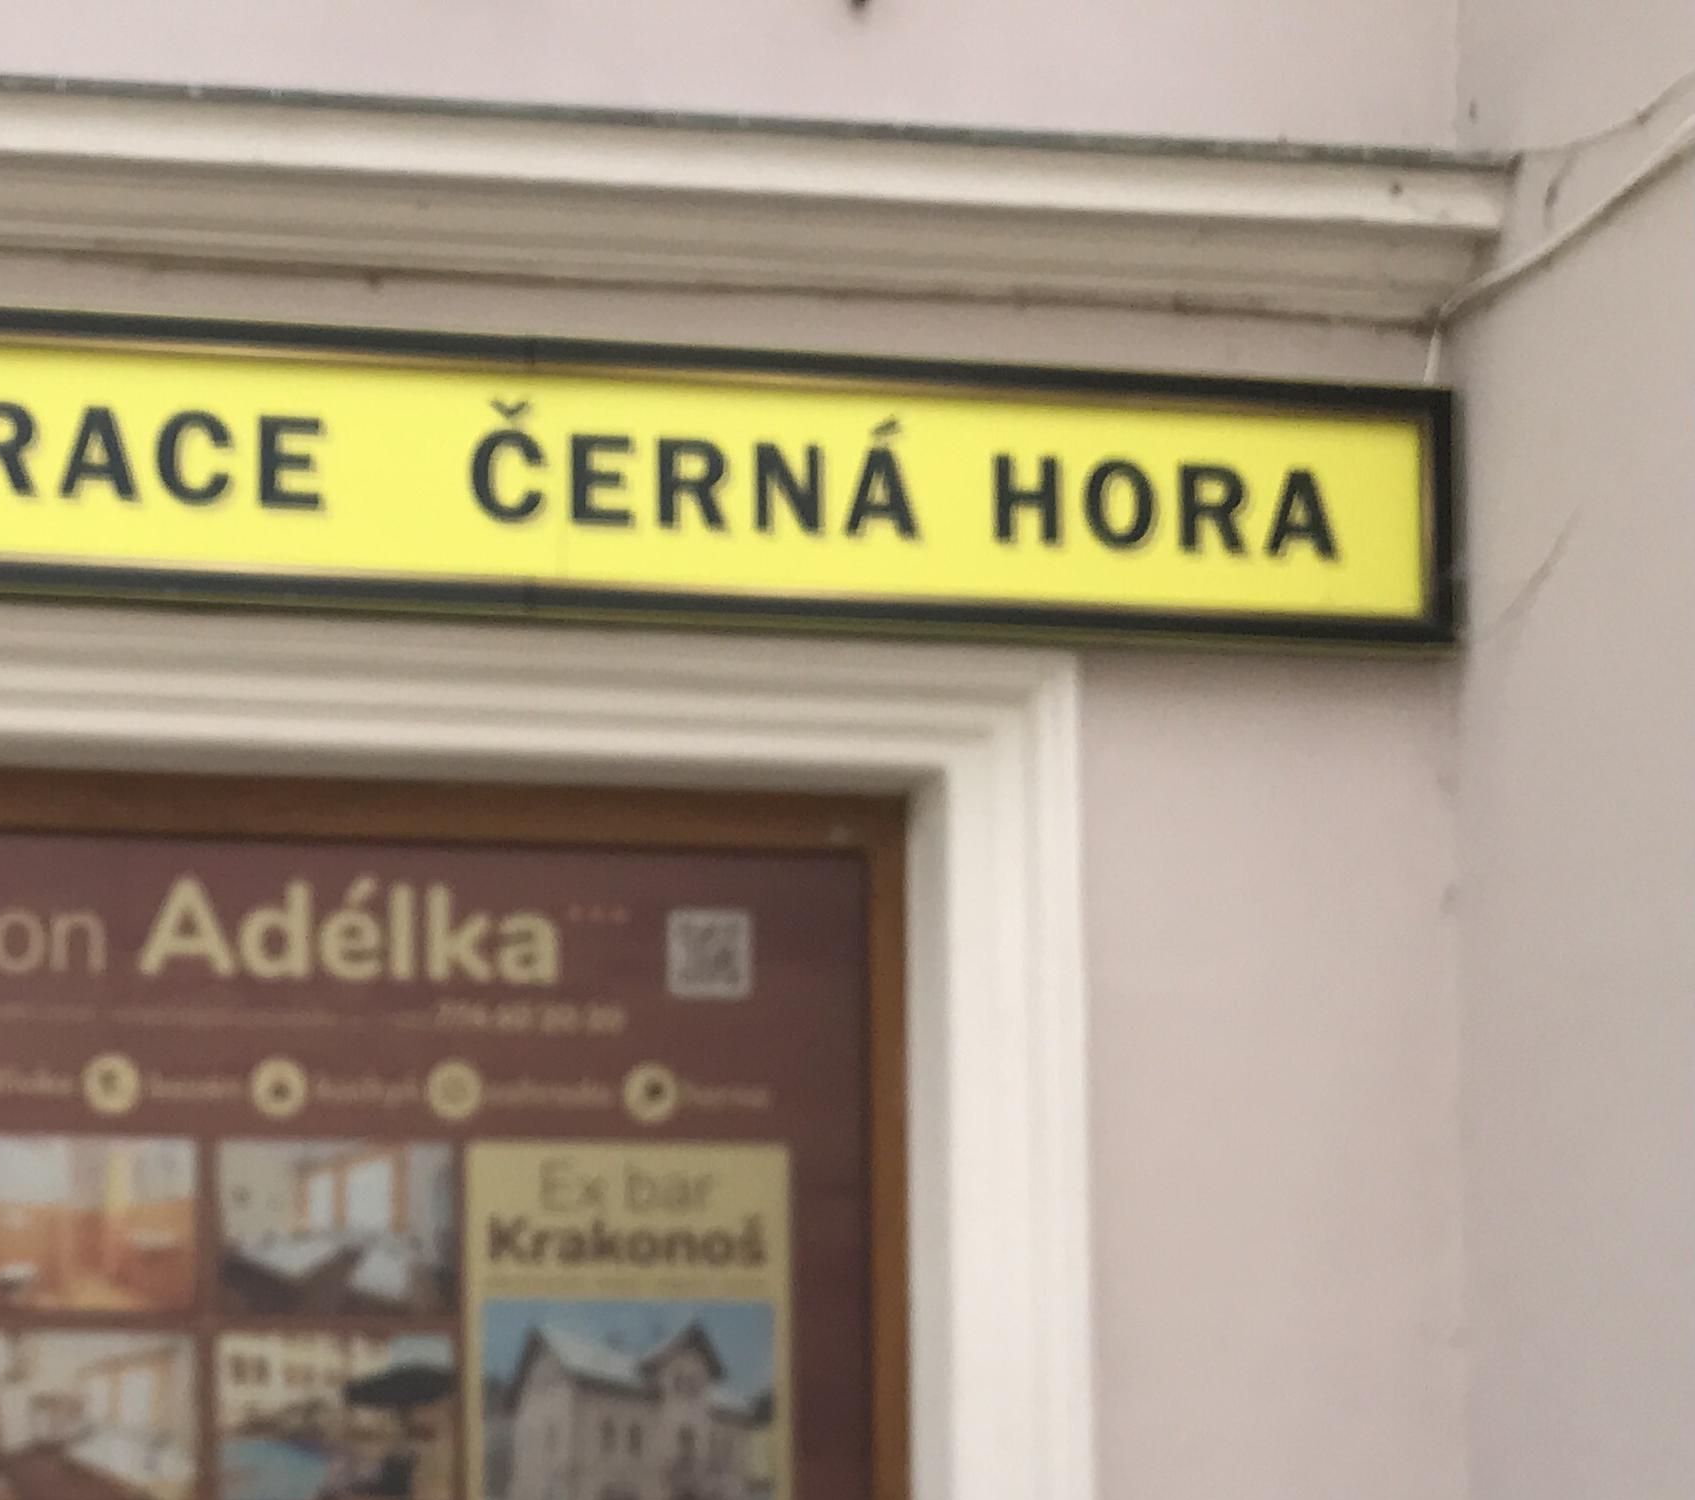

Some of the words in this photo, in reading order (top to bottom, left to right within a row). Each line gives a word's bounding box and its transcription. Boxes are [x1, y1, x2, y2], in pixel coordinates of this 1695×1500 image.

[469, 399, 920, 541] ČERNÁ
[990, 451, 1339, 561] HORA
[137, 874, 560, 986] Adélka
